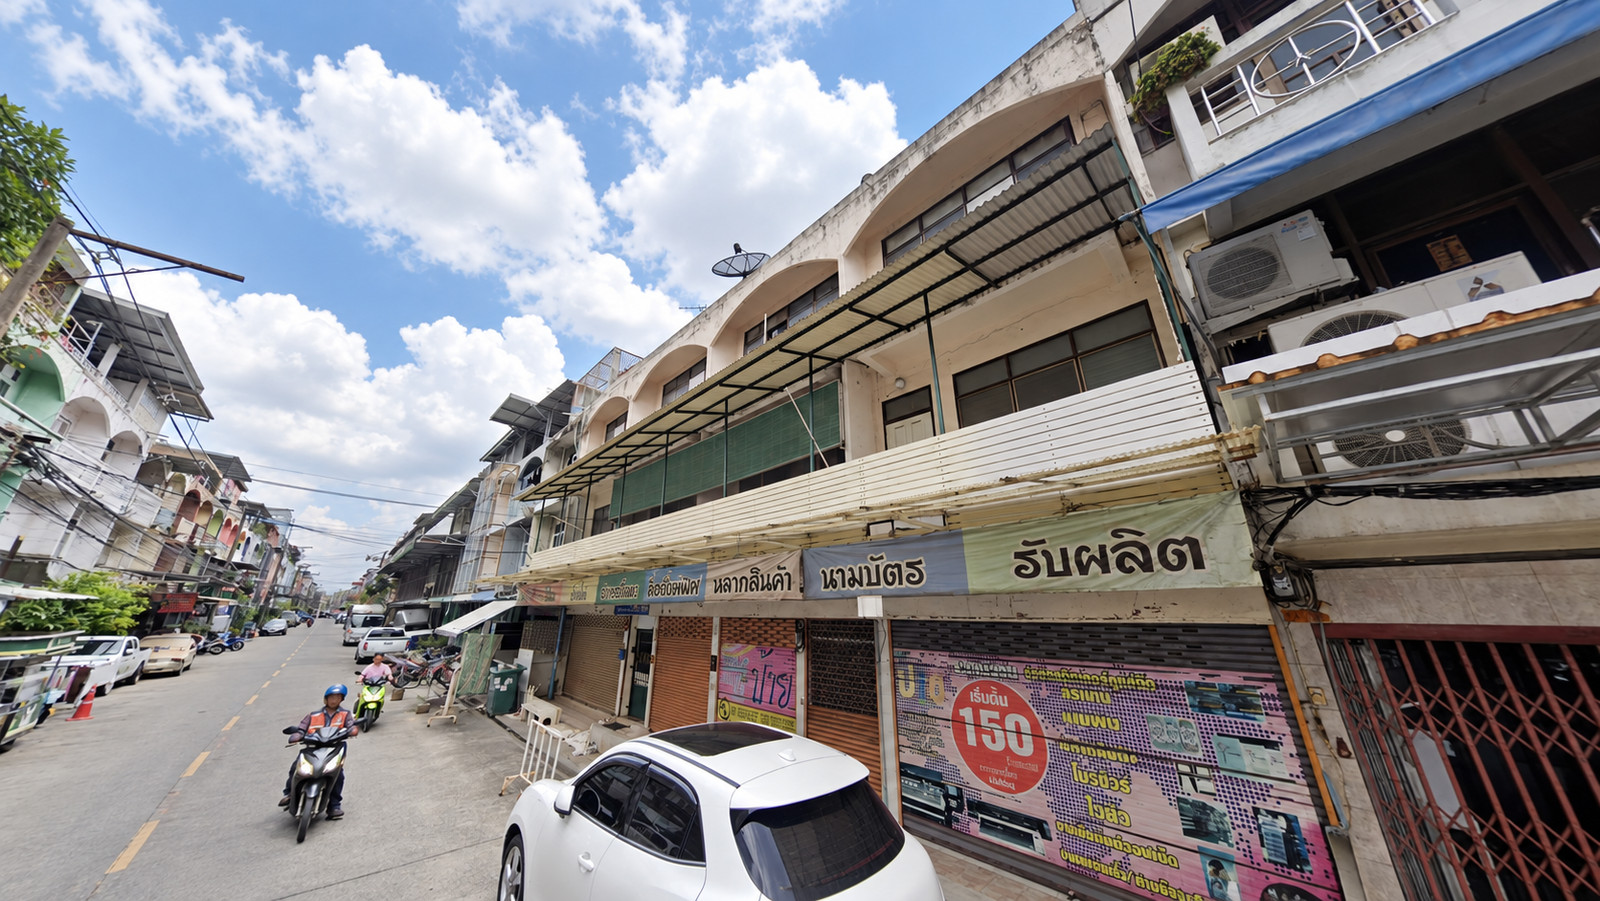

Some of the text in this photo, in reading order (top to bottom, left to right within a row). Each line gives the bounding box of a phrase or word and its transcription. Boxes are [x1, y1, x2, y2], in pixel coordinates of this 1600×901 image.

[820, 553, 925, 590] นามบัตร
[1013, 527, 1206, 579] รับผลิต
[958, 706, 1034, 757] 150
